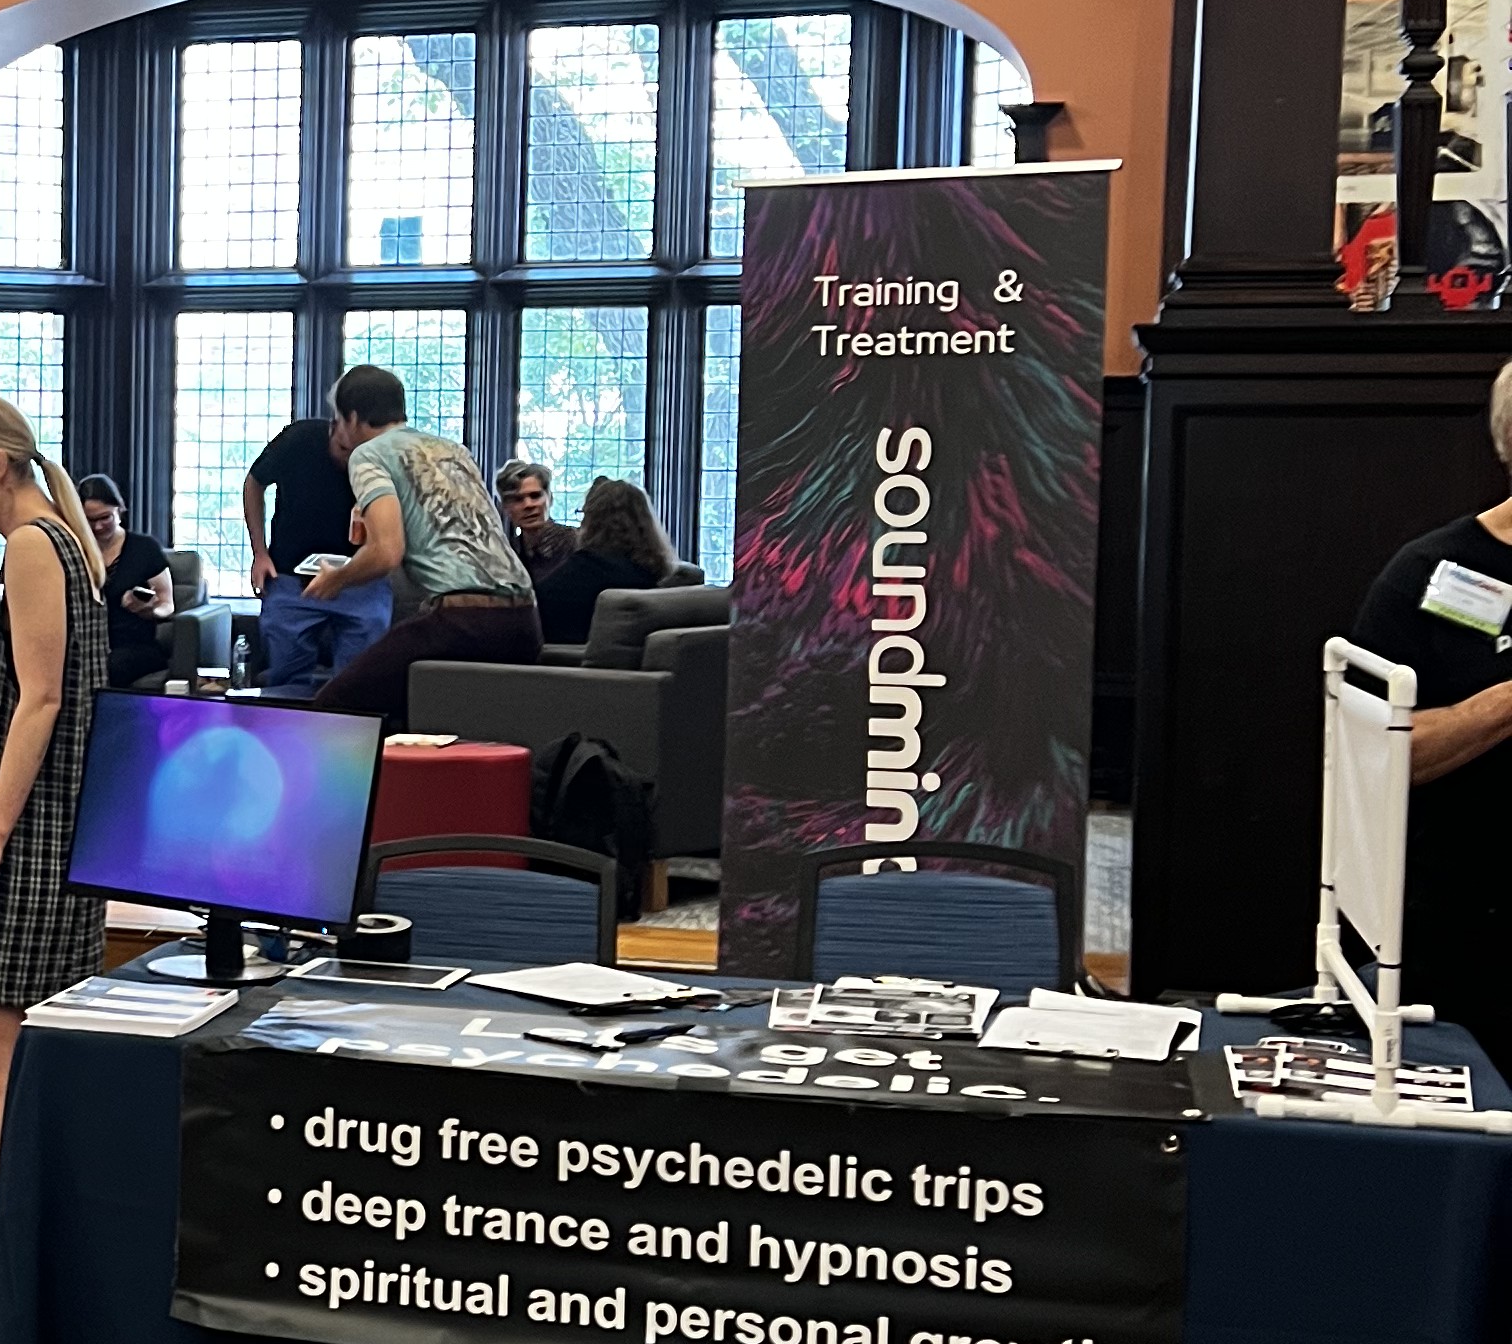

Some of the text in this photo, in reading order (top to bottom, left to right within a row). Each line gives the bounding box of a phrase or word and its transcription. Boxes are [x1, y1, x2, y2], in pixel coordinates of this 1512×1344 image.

[813, 269, 1025, 313] Training &
[810, 322, 1016, 357] Treatment
[303, 1106, 1045, 1223] drug free psychedelic trips
[300, 1180, 1014, 1294] deep trance and hypnosis
[298, 1259, 509, 1317] spiritual
[527, 1286, 626, 1330] and
